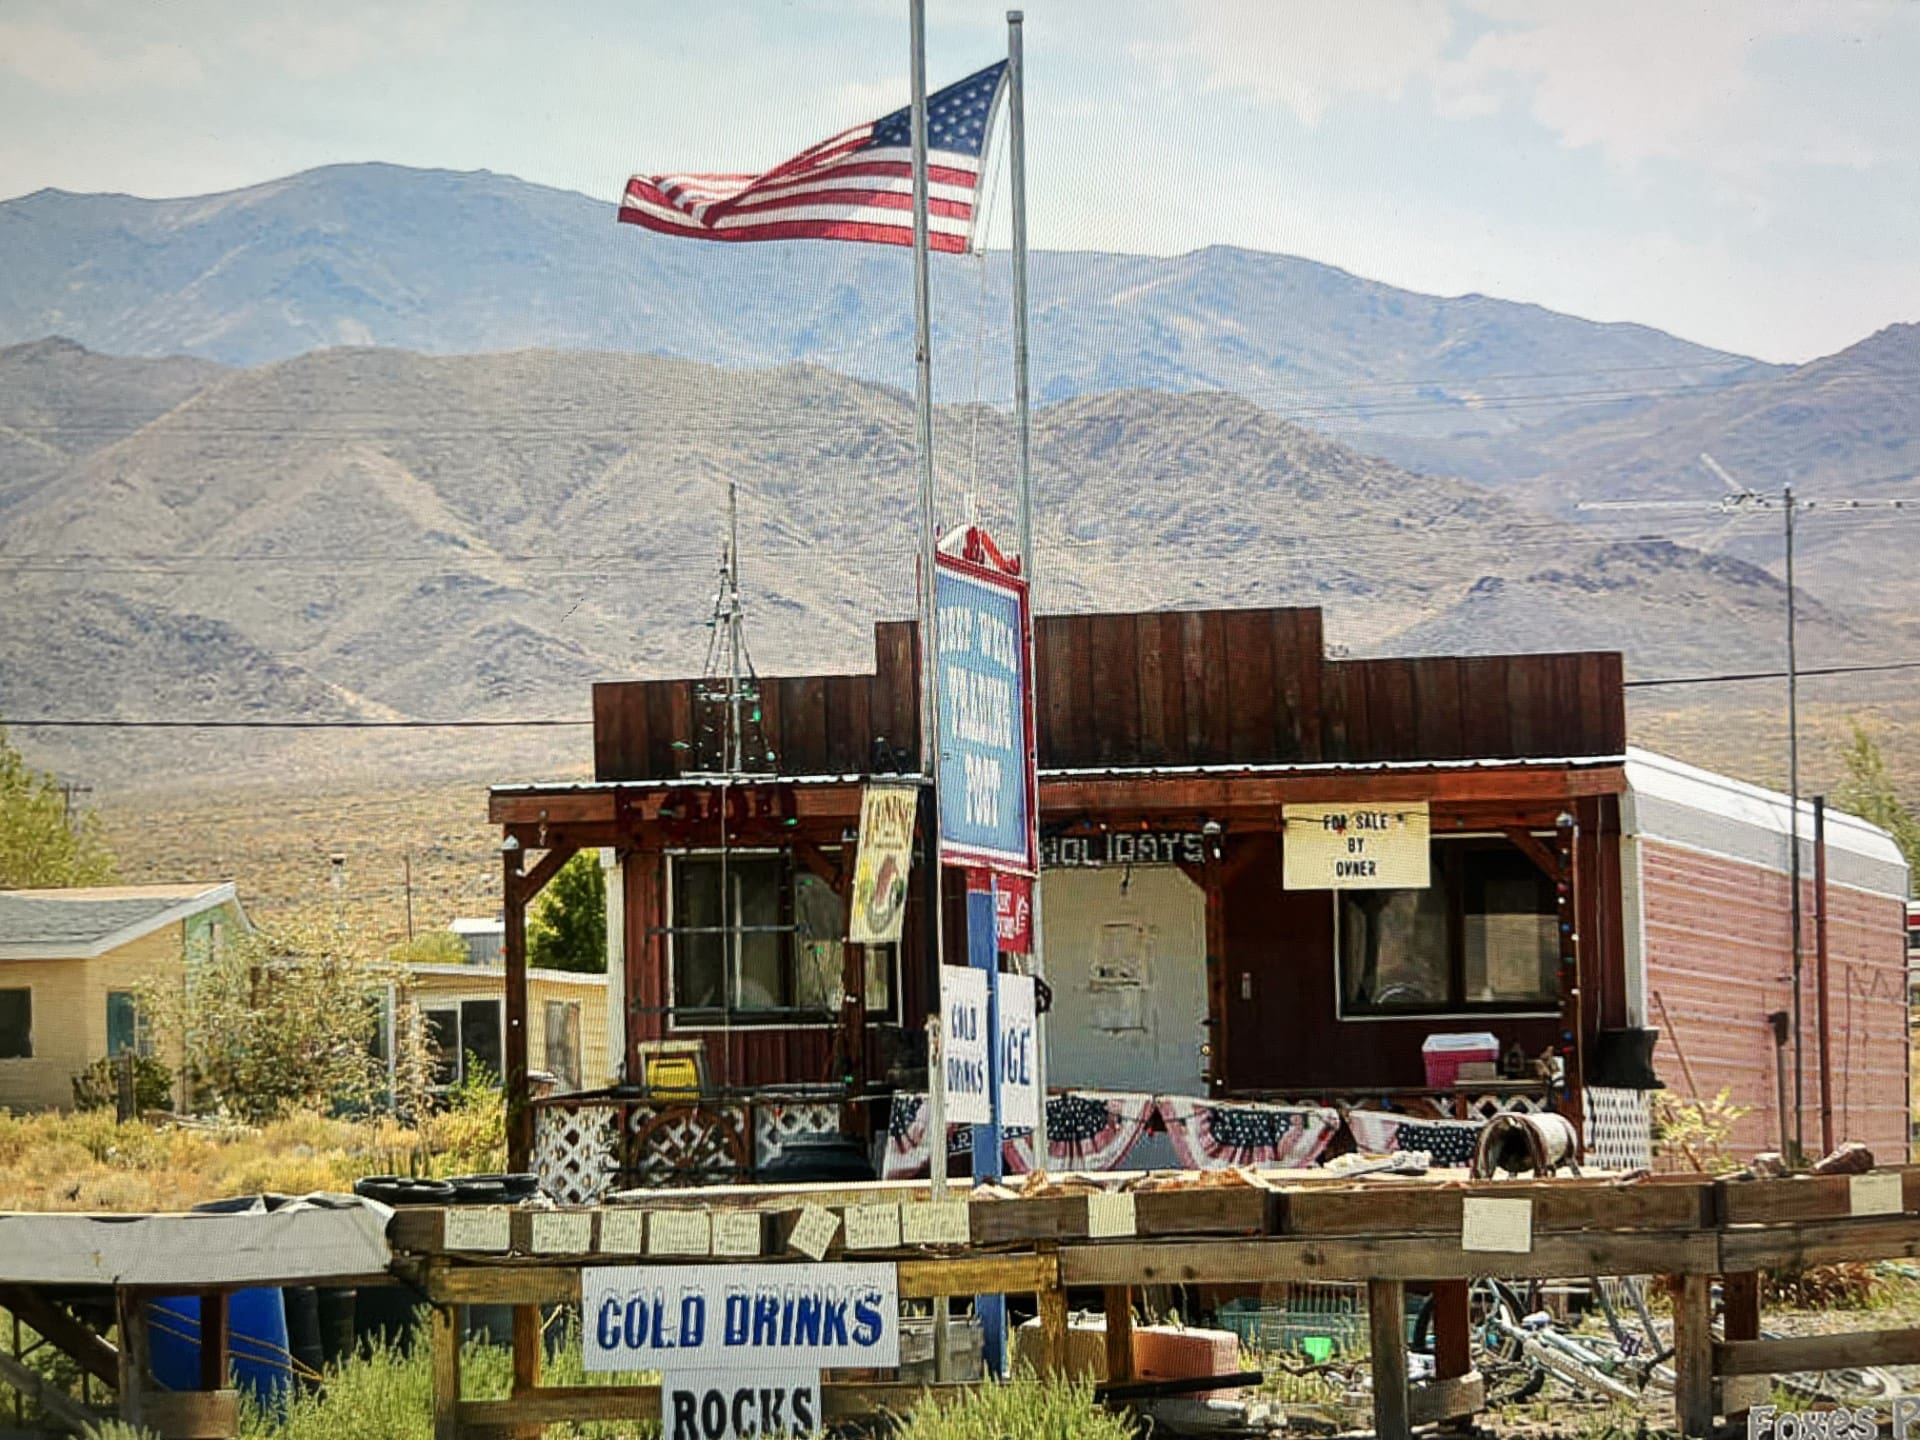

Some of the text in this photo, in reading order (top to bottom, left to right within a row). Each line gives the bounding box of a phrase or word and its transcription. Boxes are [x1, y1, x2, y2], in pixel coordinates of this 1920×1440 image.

[1323, 812, 1388, 830] FOR SALE
[1040, 833, 1205, 866] HOLIDAYS
[1347, 837, 1364, 853] BY
[1336, 860, 1377, 877] OWNER
[951, 1002, 976, 1041] COLD
[948, 1056, 984, 1095] DRINKS
[1000, 1027, 1031, 1086] ICE
[597, 1288, 883, 1350] COLD DRINKS
[671, 1387, 813, 1440] ROCKS
